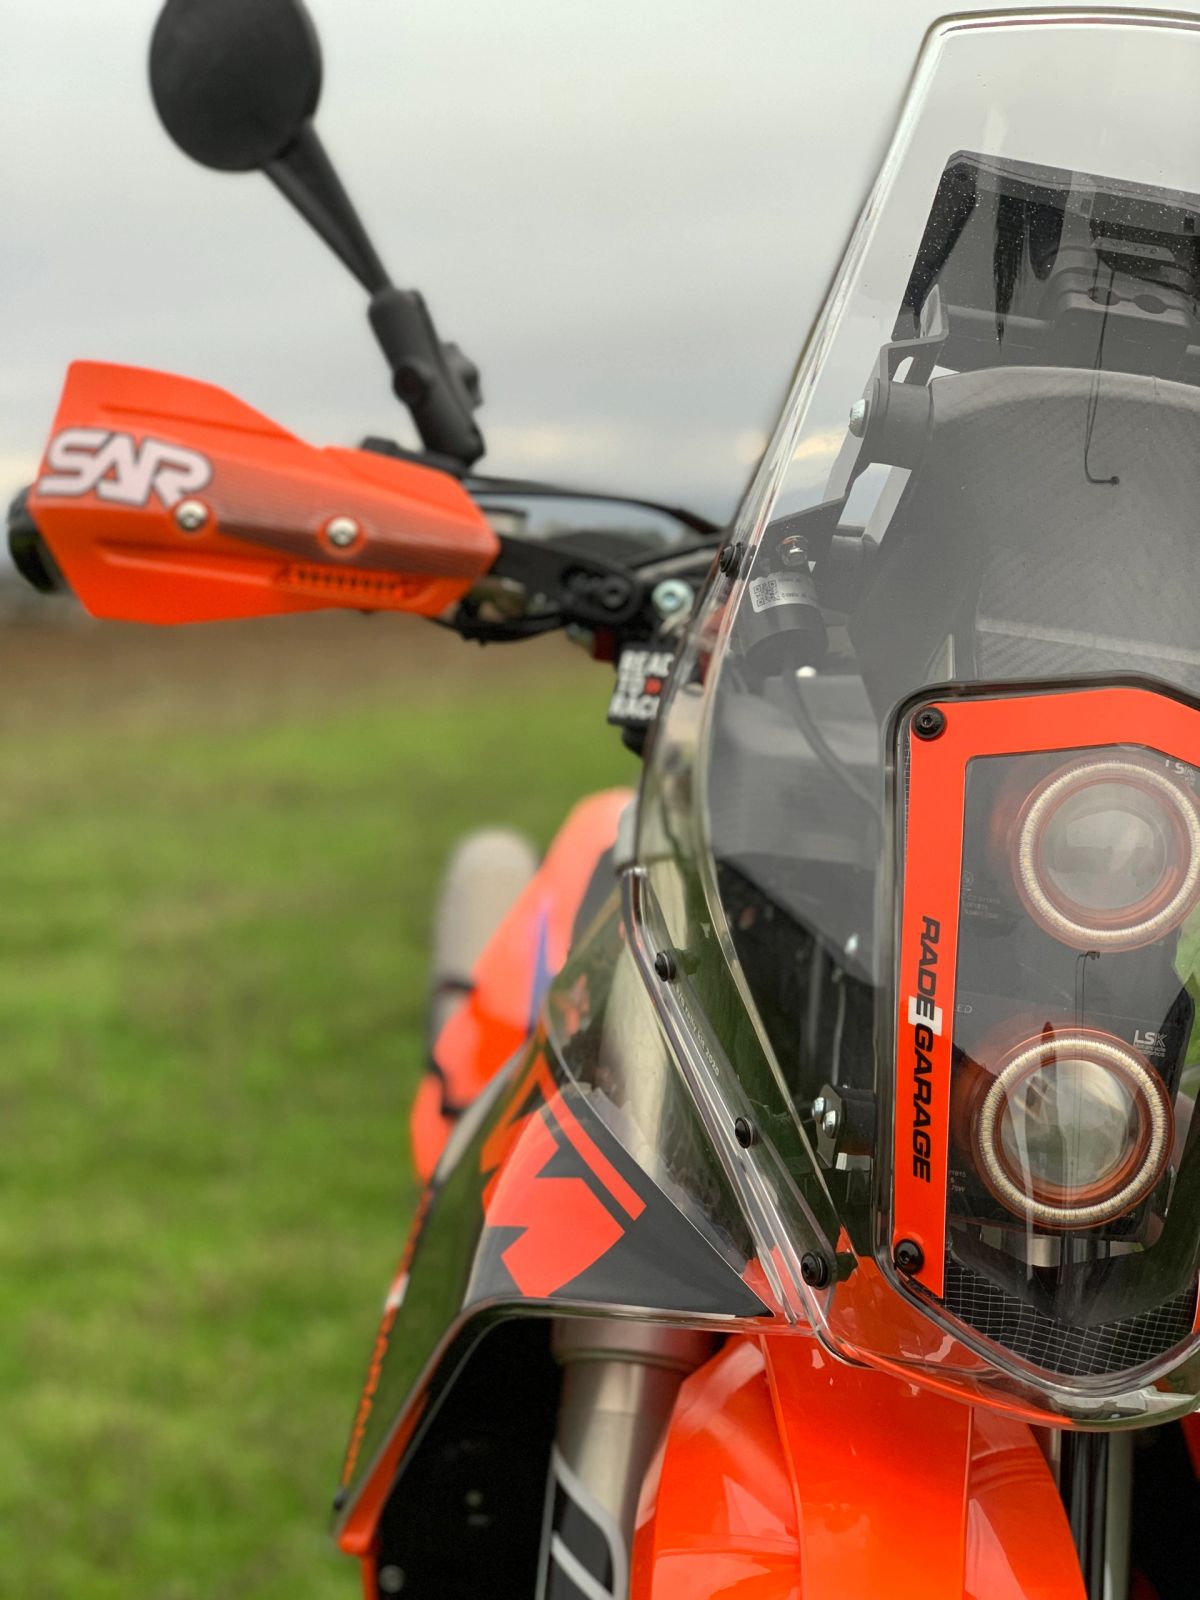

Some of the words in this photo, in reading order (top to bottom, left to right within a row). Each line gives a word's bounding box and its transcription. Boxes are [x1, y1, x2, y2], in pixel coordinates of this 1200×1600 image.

[37, 427, 213, 508] SAR
[916, 915, 940, 1021] RADE
[912, 1022, 934, 1184] GARAGE
